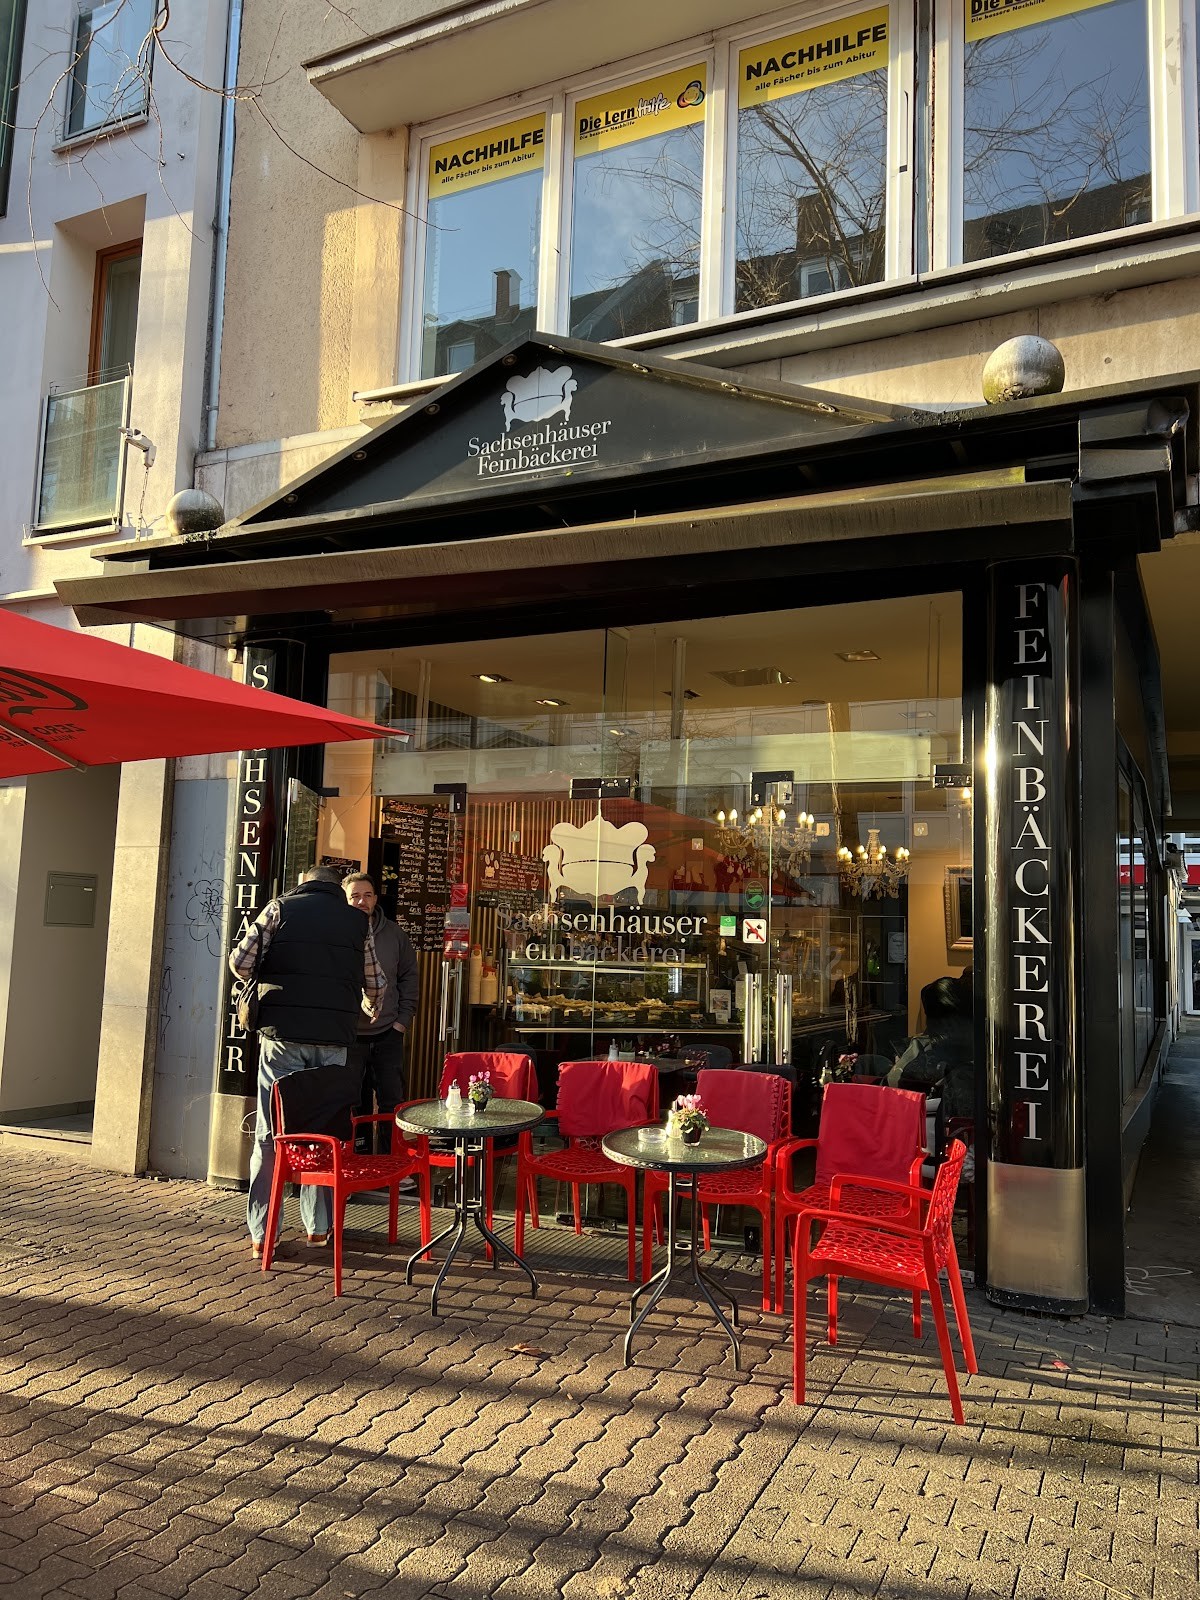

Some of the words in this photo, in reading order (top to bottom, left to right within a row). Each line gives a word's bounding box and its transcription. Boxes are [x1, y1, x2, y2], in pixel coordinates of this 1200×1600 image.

[746, 23, 887, 80] NACHHILFE
[755, 82, 771, 91] alle
[773, 71, 805, 85] Fächer
[807, 66, 821, 76] bis
[823, 60, 843, 71] zum
[845, 50, 877, 64] Abitur
[580, 116, 602, 133] Die
[435, 128, 544, 174] NACHHILFE
[441, 176, 454, 184] alle
[456, 168, 480, 180] Fächer
[482, 164, 493, 172] bis
[494, 160, 510, 169] zum
[512, 152, 536, 164] Abitur
[467, 420, 612, 457] Sachsenhäuser
[476, 437, 599, 476] Feinbäckerei
[1011, 582, 1052, 1140] FEINBÄCKEREI
[496, 902, 708, 936] Sachsenhäuser
